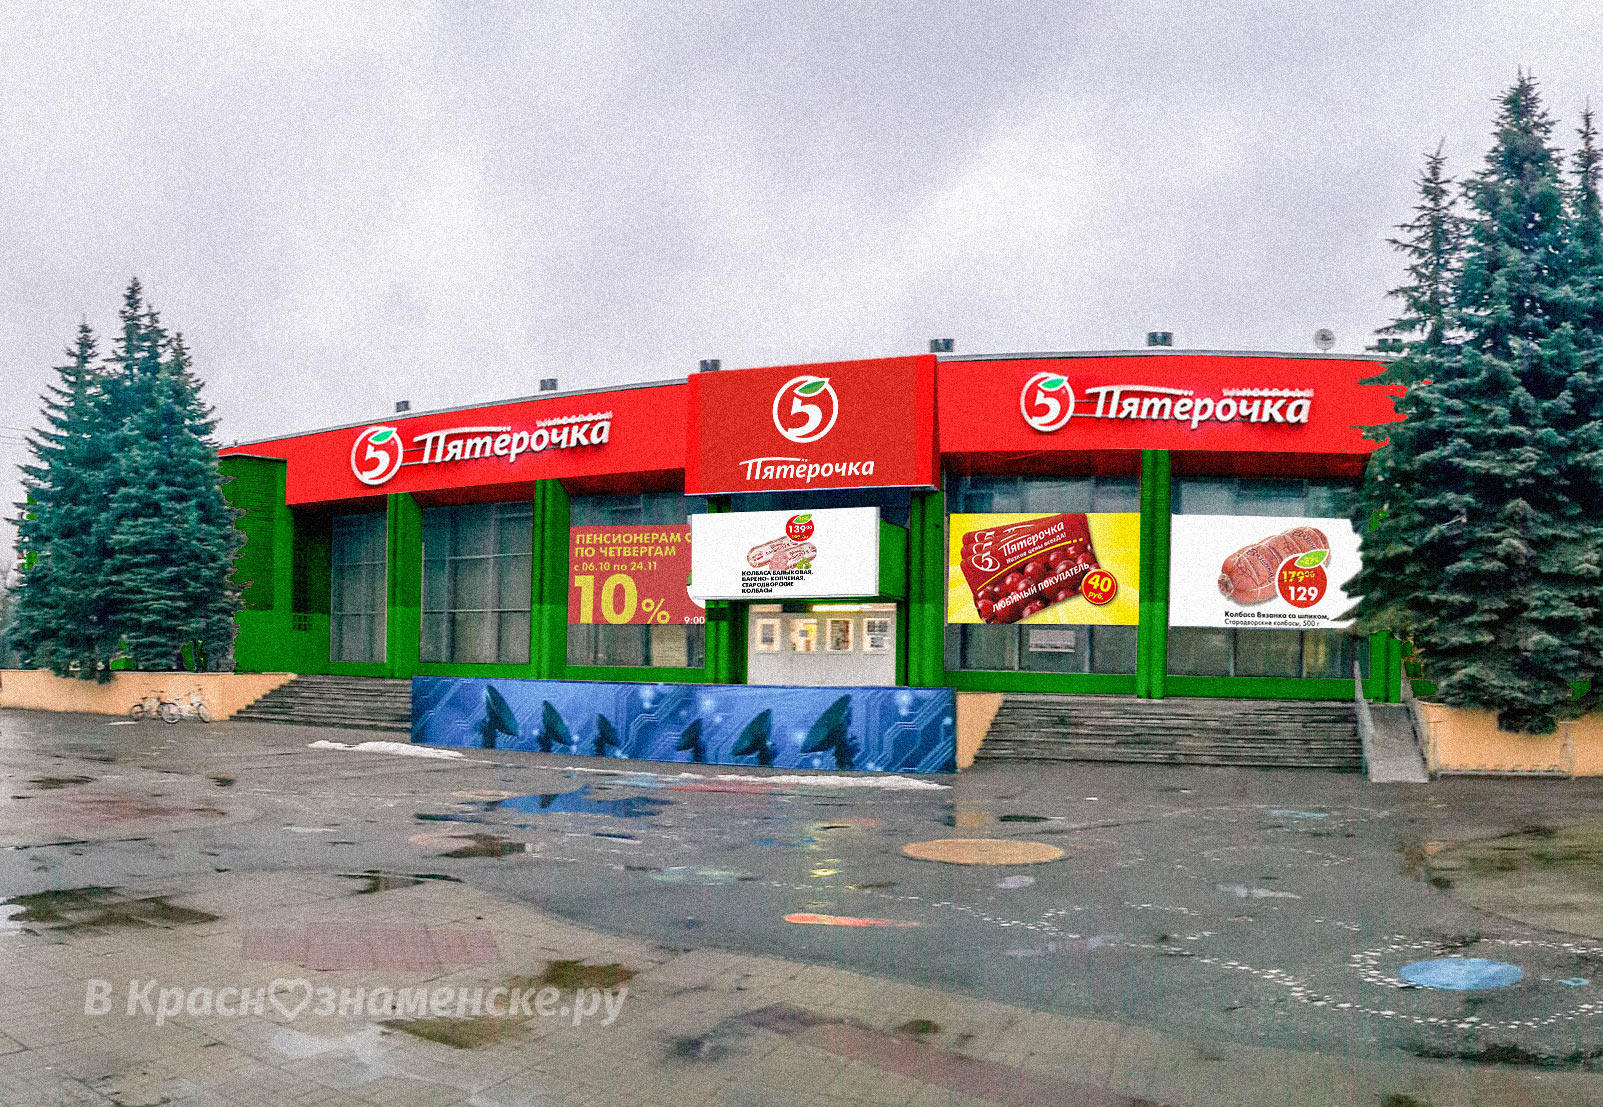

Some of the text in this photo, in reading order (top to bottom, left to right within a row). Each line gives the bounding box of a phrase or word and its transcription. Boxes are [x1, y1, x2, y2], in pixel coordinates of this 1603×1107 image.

[1085, 384, 1312, 430] Пятёрочка
[413, 420, 612, 463] Пятёрочка
[739, 456, 875, 483] Пятёрочка
[576, 532, 681, 544] ПЕНСИОНЕРАМ
[575, 546, 676, 557] ПО ЧЕТВЕРГАМ
[582, 562, 611, 571] 06.10
[630, 561, 657, 571] 24.11
[992, 561, 1090, 613] ЛЮБИМЫЙ ПОКУПАТЕЛЬ
[1087, 573, 1112, 592] 40
[1288, 586, 1319, 601] 129
